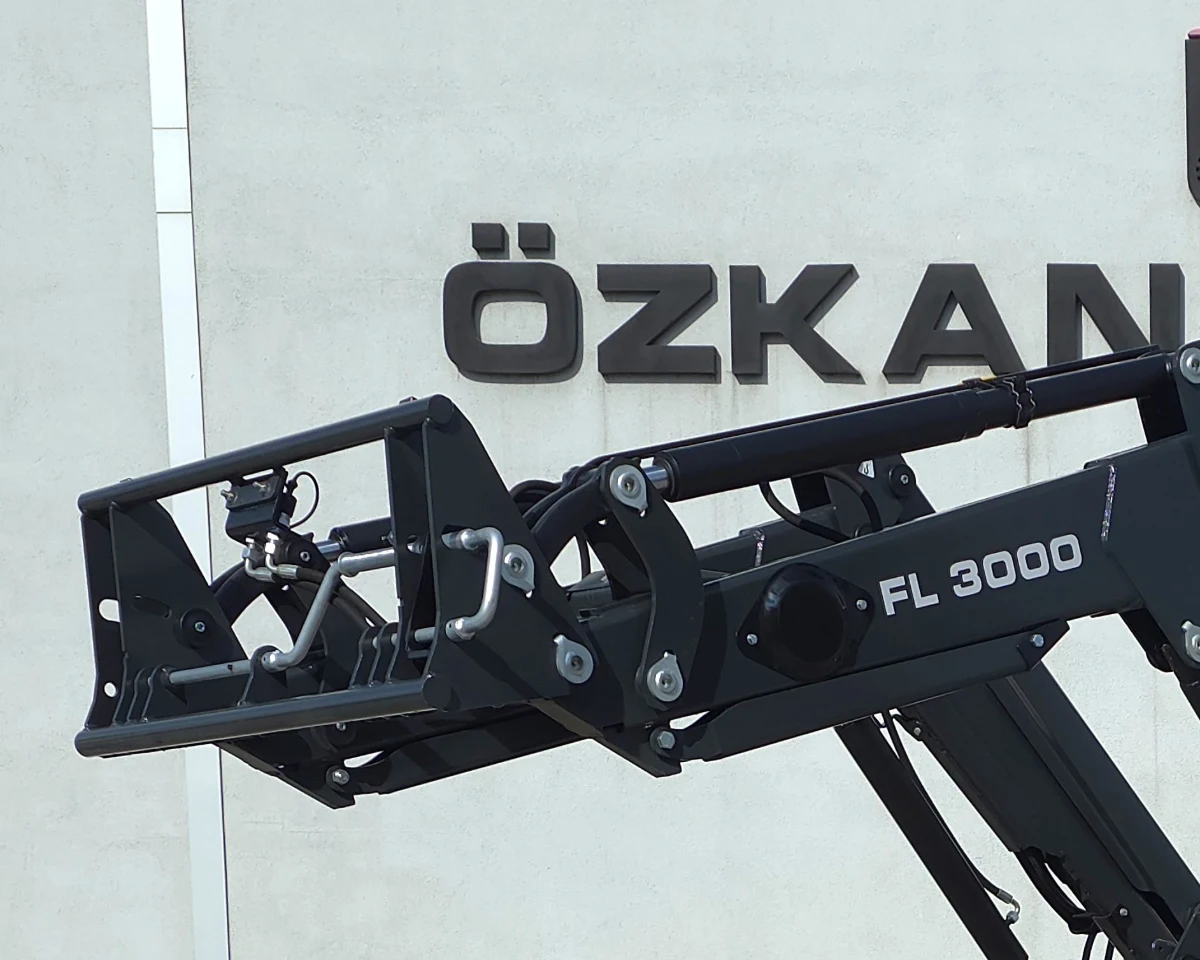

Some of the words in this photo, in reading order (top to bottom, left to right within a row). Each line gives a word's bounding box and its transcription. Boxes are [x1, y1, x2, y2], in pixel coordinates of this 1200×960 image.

[442, 222, 1186, 382] ÖZKAN
[879, 572, 940, 616] FL
[949, 533, 1083, 598] 3000
